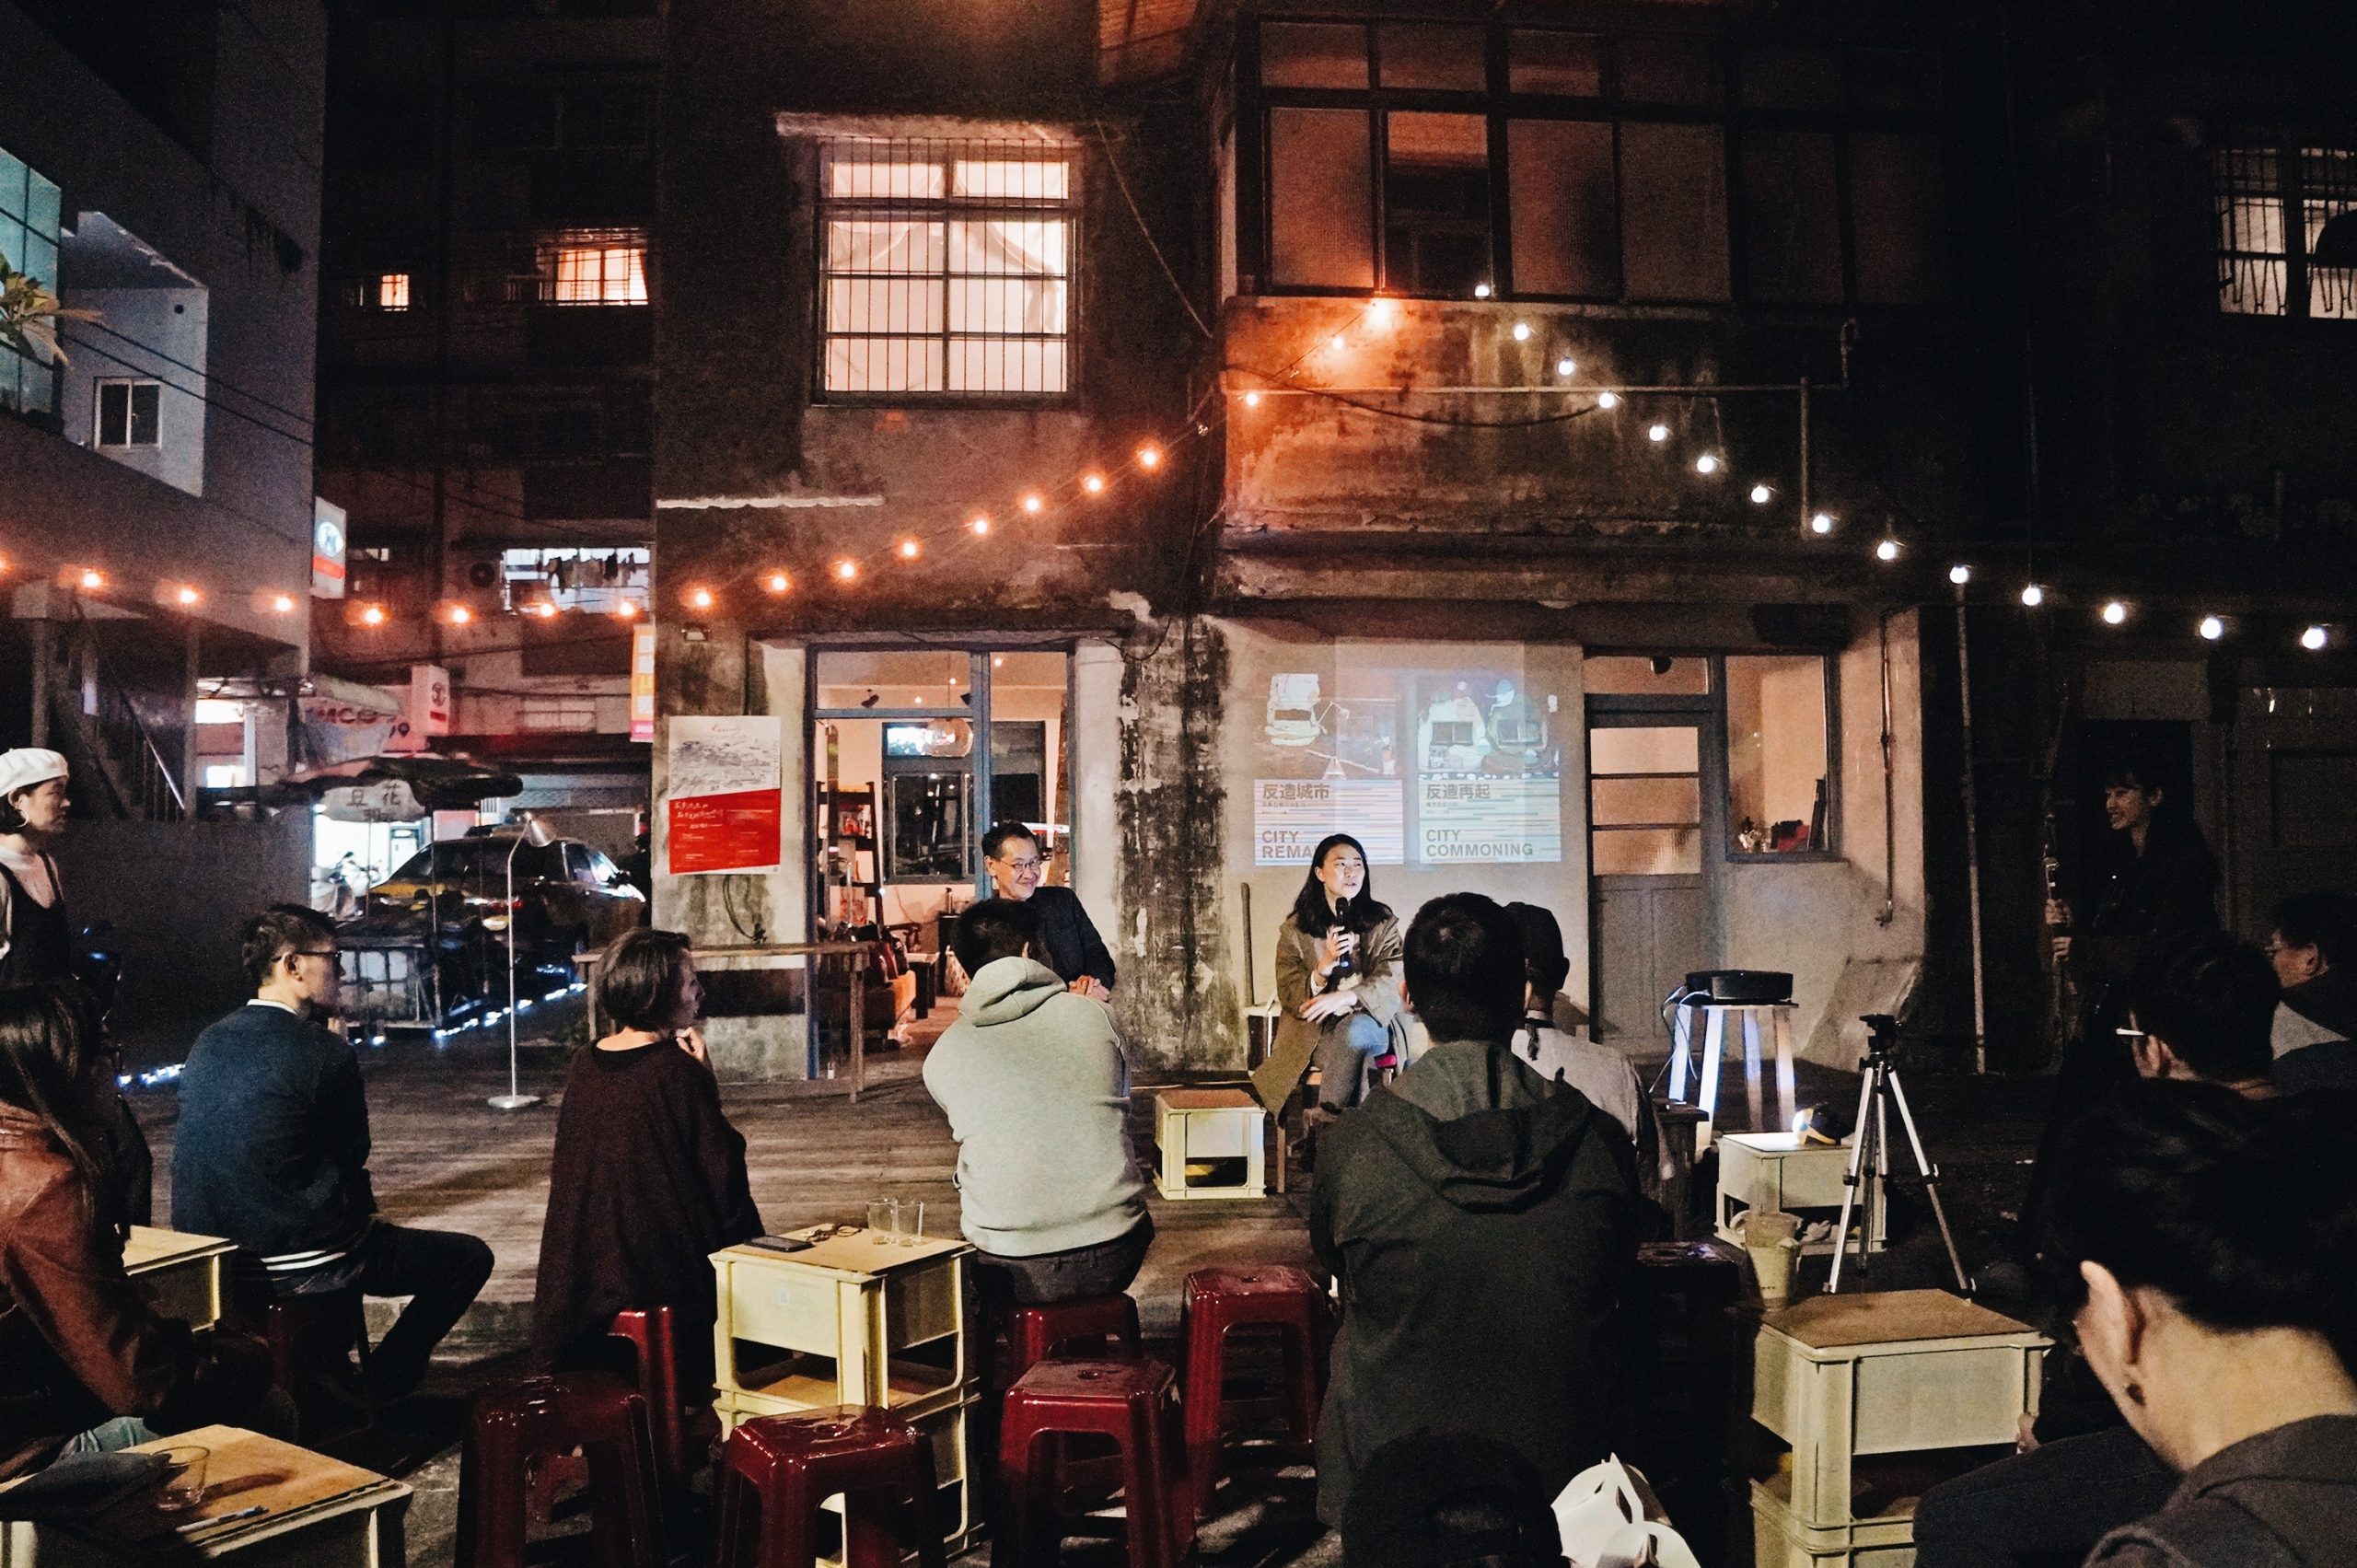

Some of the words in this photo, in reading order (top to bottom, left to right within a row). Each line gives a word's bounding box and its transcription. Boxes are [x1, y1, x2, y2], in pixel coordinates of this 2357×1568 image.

[346, 783, 401, 807] 豆花
[1262, 784, 1330, 800] 反造城市
[1426, 784, 1491, 799] 反造再起
[1261, 830, 1299, 843] CITY
[1426, 830, 1460, 842] CITY
[1261, 845, 1318, 859] REMA
[1426, 842, 1533, 857] COMMONING
